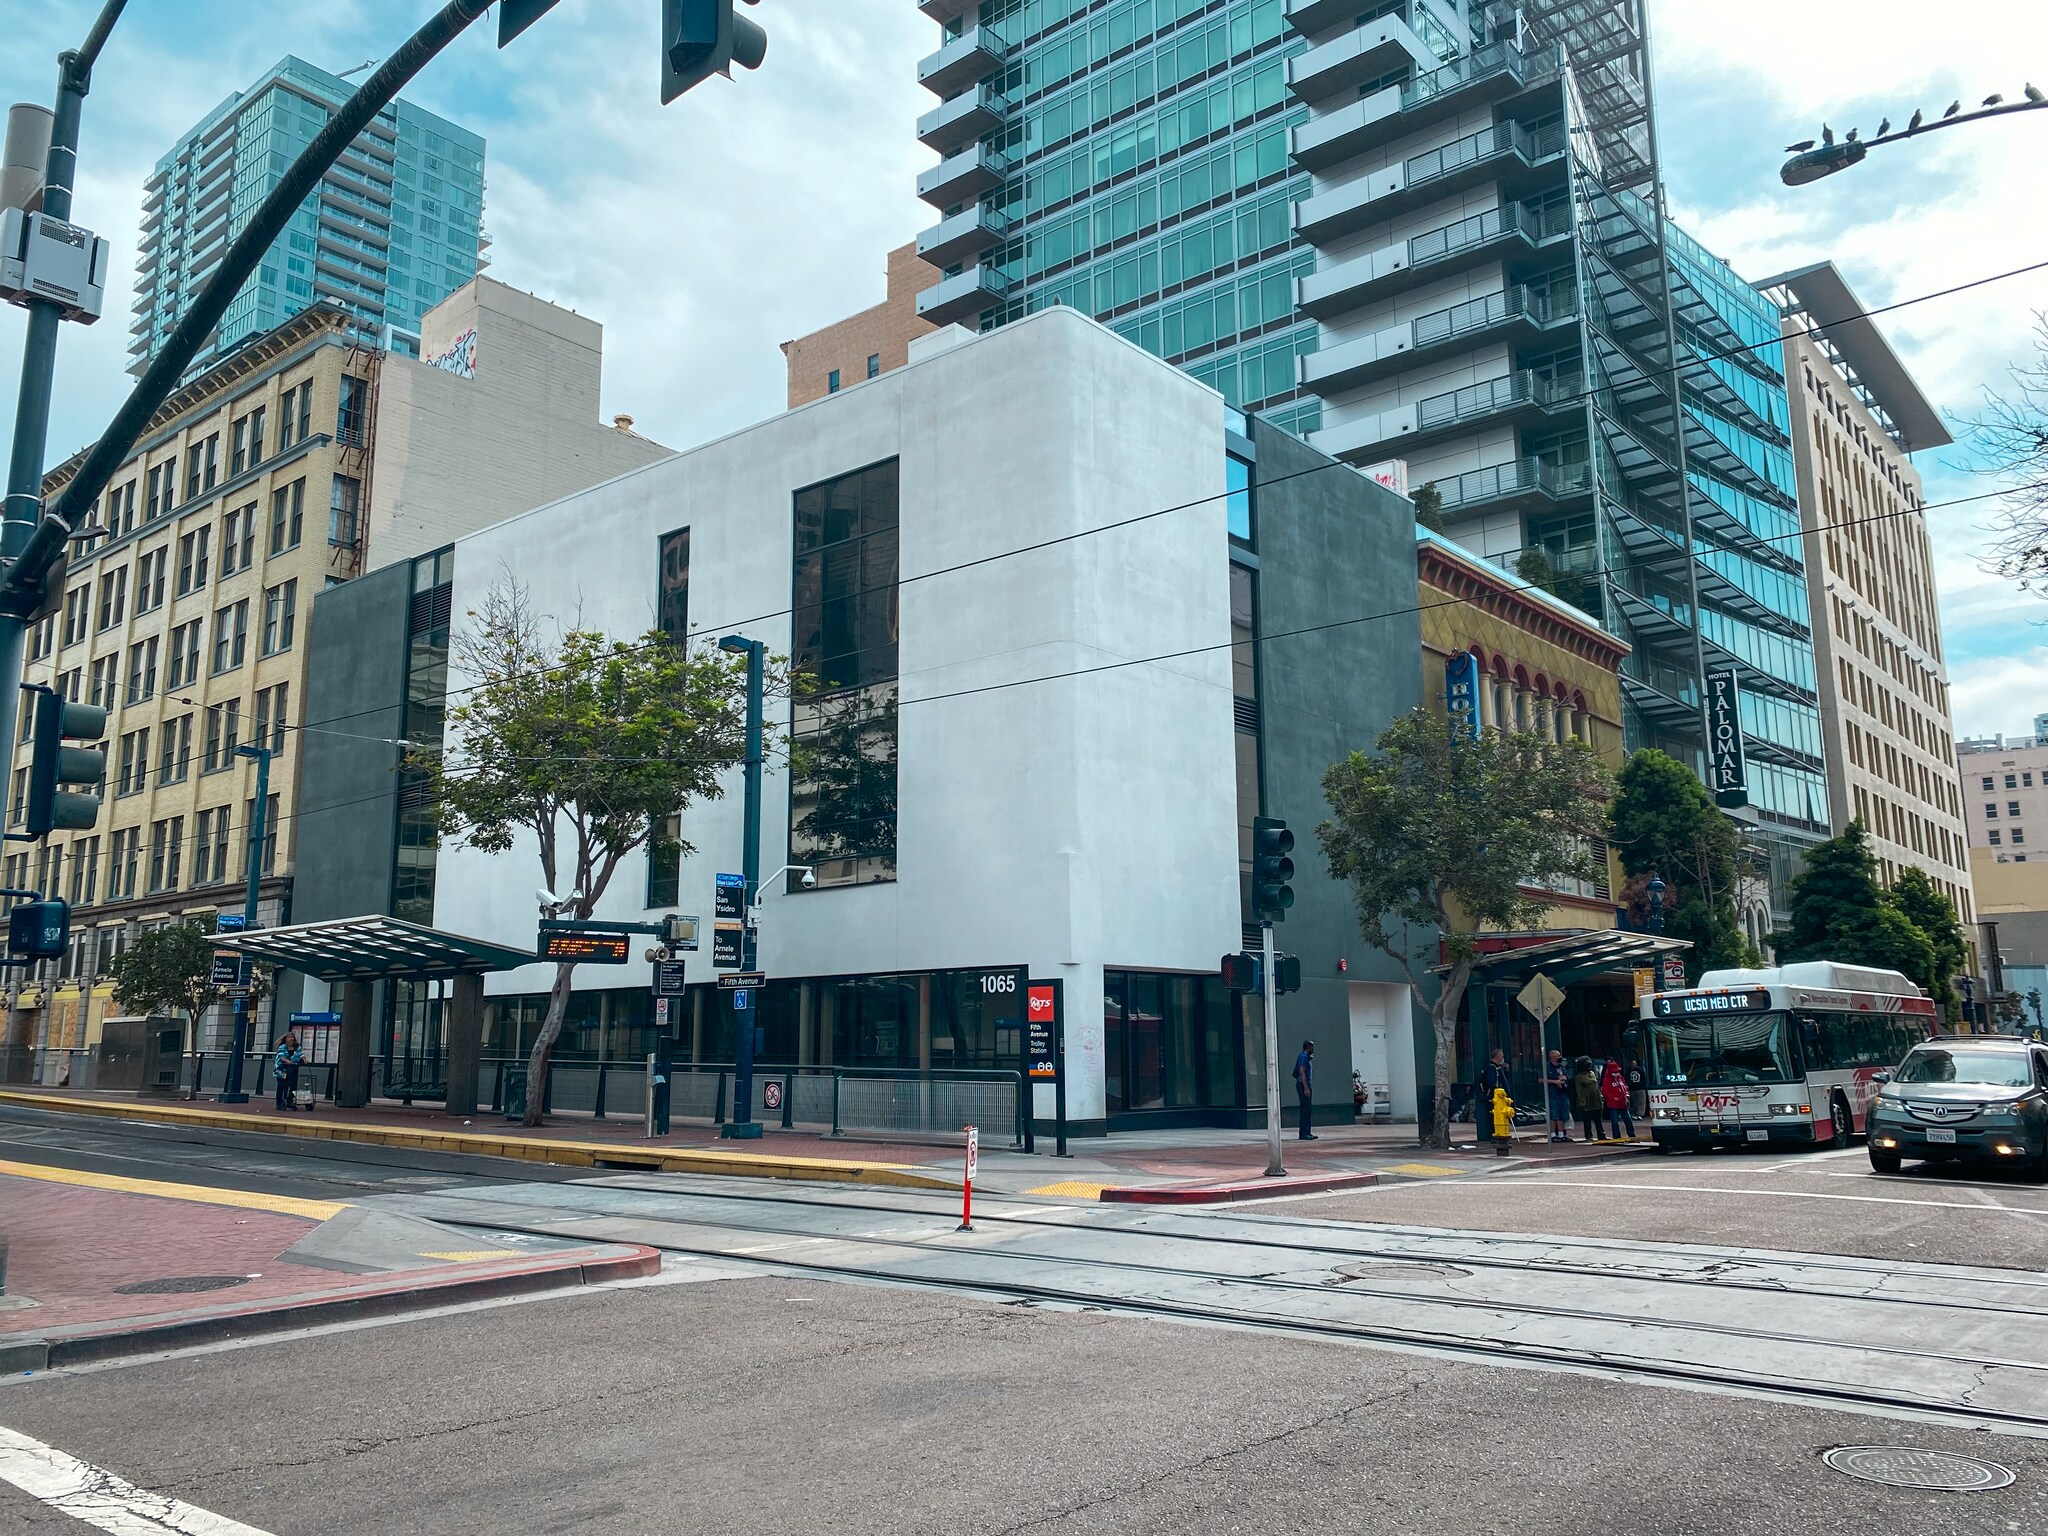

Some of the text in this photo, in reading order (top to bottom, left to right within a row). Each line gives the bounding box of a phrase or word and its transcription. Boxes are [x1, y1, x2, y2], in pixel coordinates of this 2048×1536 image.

[1708, 672, 1731, 680] HOTEL
[1715, 681, 1738, 784] PALOMAR
[725, 977, 759, 986] Fifth Avenue
[980, 975, 1015, 993] 1065
[1662, 995, 1749, 1014] 3 UCSD MED CTR
[1030, 1040, 1045, 1048] Trolley
[1666, 1074, 1687, 1082] $2.50
[1702, 1096, 1740, 1107] MTS
